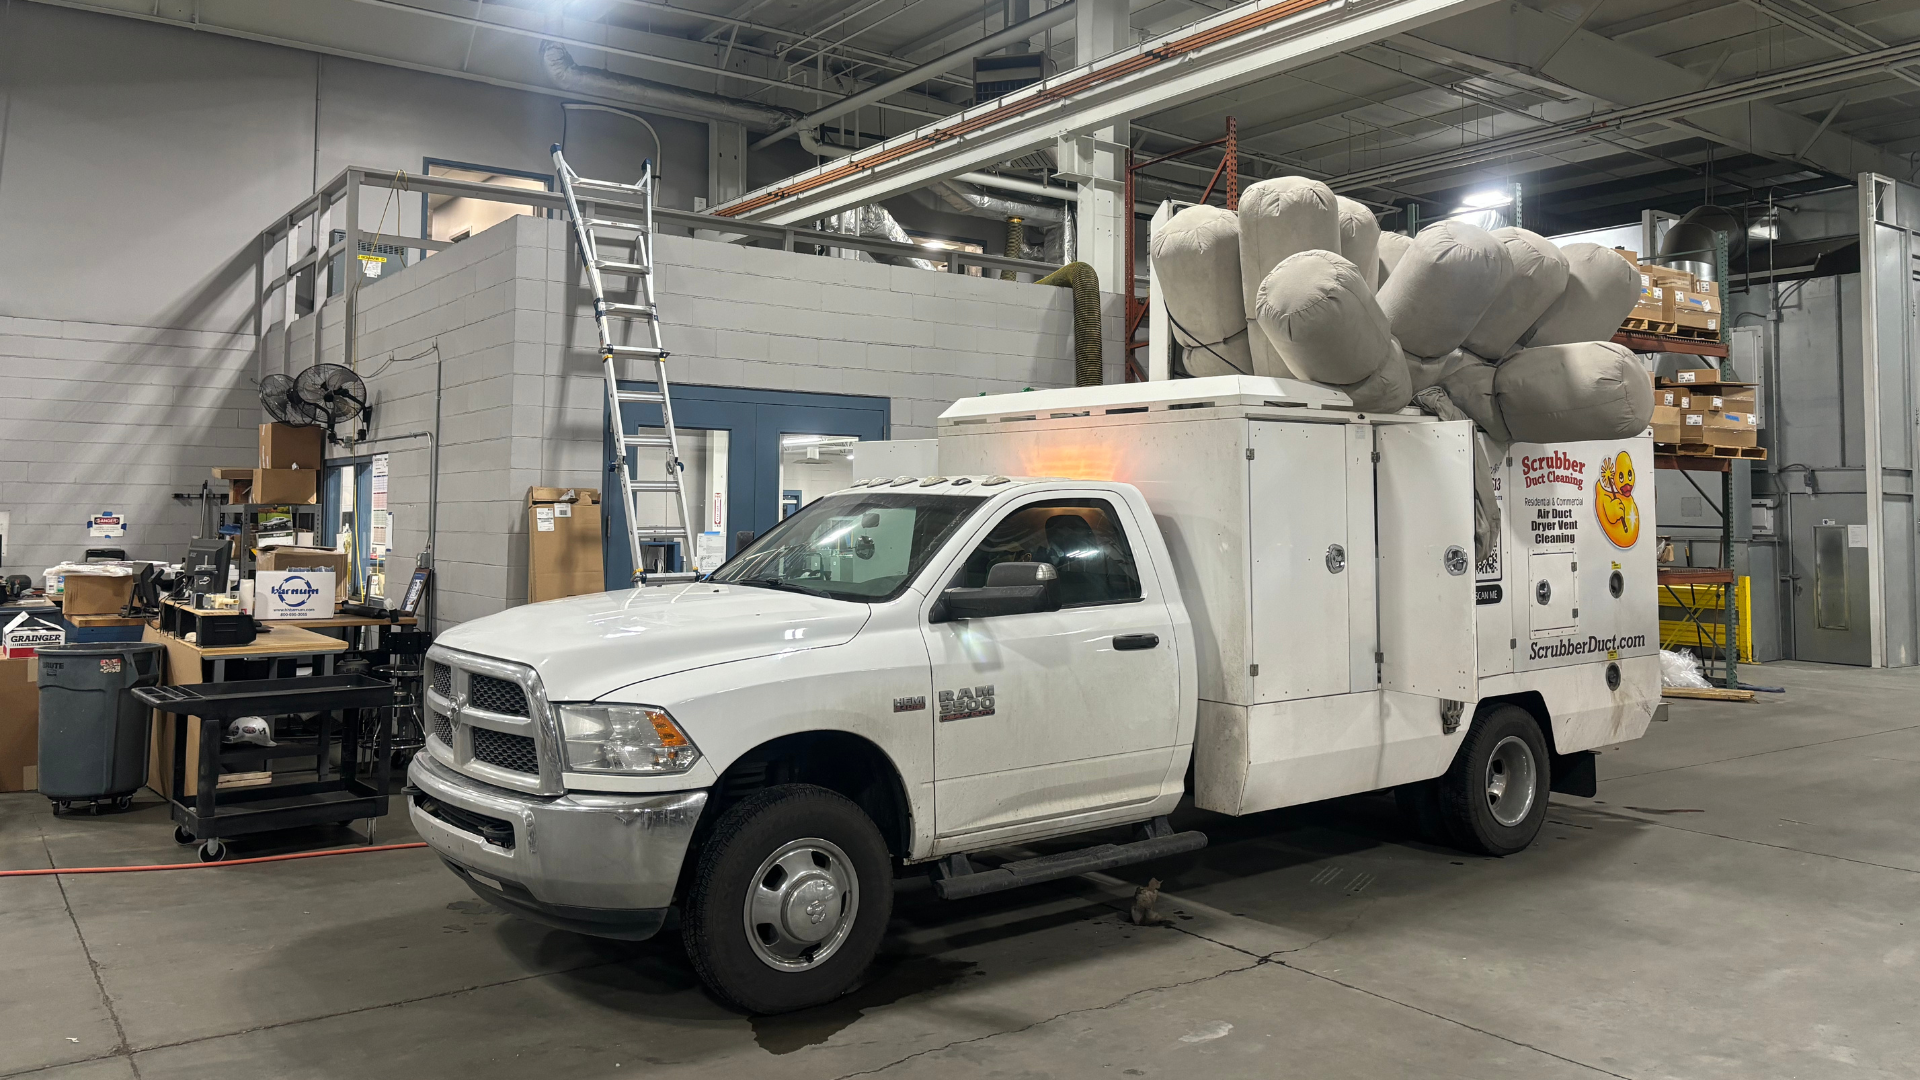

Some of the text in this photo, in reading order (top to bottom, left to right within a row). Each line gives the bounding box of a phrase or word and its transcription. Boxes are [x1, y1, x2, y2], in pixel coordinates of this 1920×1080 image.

[1521, 450, 1586, 476] Scrubber
[1524, 473, 1546, 489] Duct
[1547, 470, 1584, 491] Cleaning
[1524, 497, 1584, 507] Residential & Commercial
[1537, 508, 1573, 519] Air Duct
[1531, 519, 1578, 532] Dryer Vent
[1535, 532, 1575, 544] Cleaning
[271, 585, 319, 595] barnum
[1489, 590, 1498, 599] ME
[10, 634, 61, 643] GRAINGER
[1529, 634, 1646, 660] ScrubberDuct.com
[42, 661, 65, 670] BRUTE
[938, 684, 995, 703] RAM
[894, 696, 926, 706] HEMI
[939, 696, 996, 714] 3500
[942, 709, 993, 721] HEAVY DUTY
